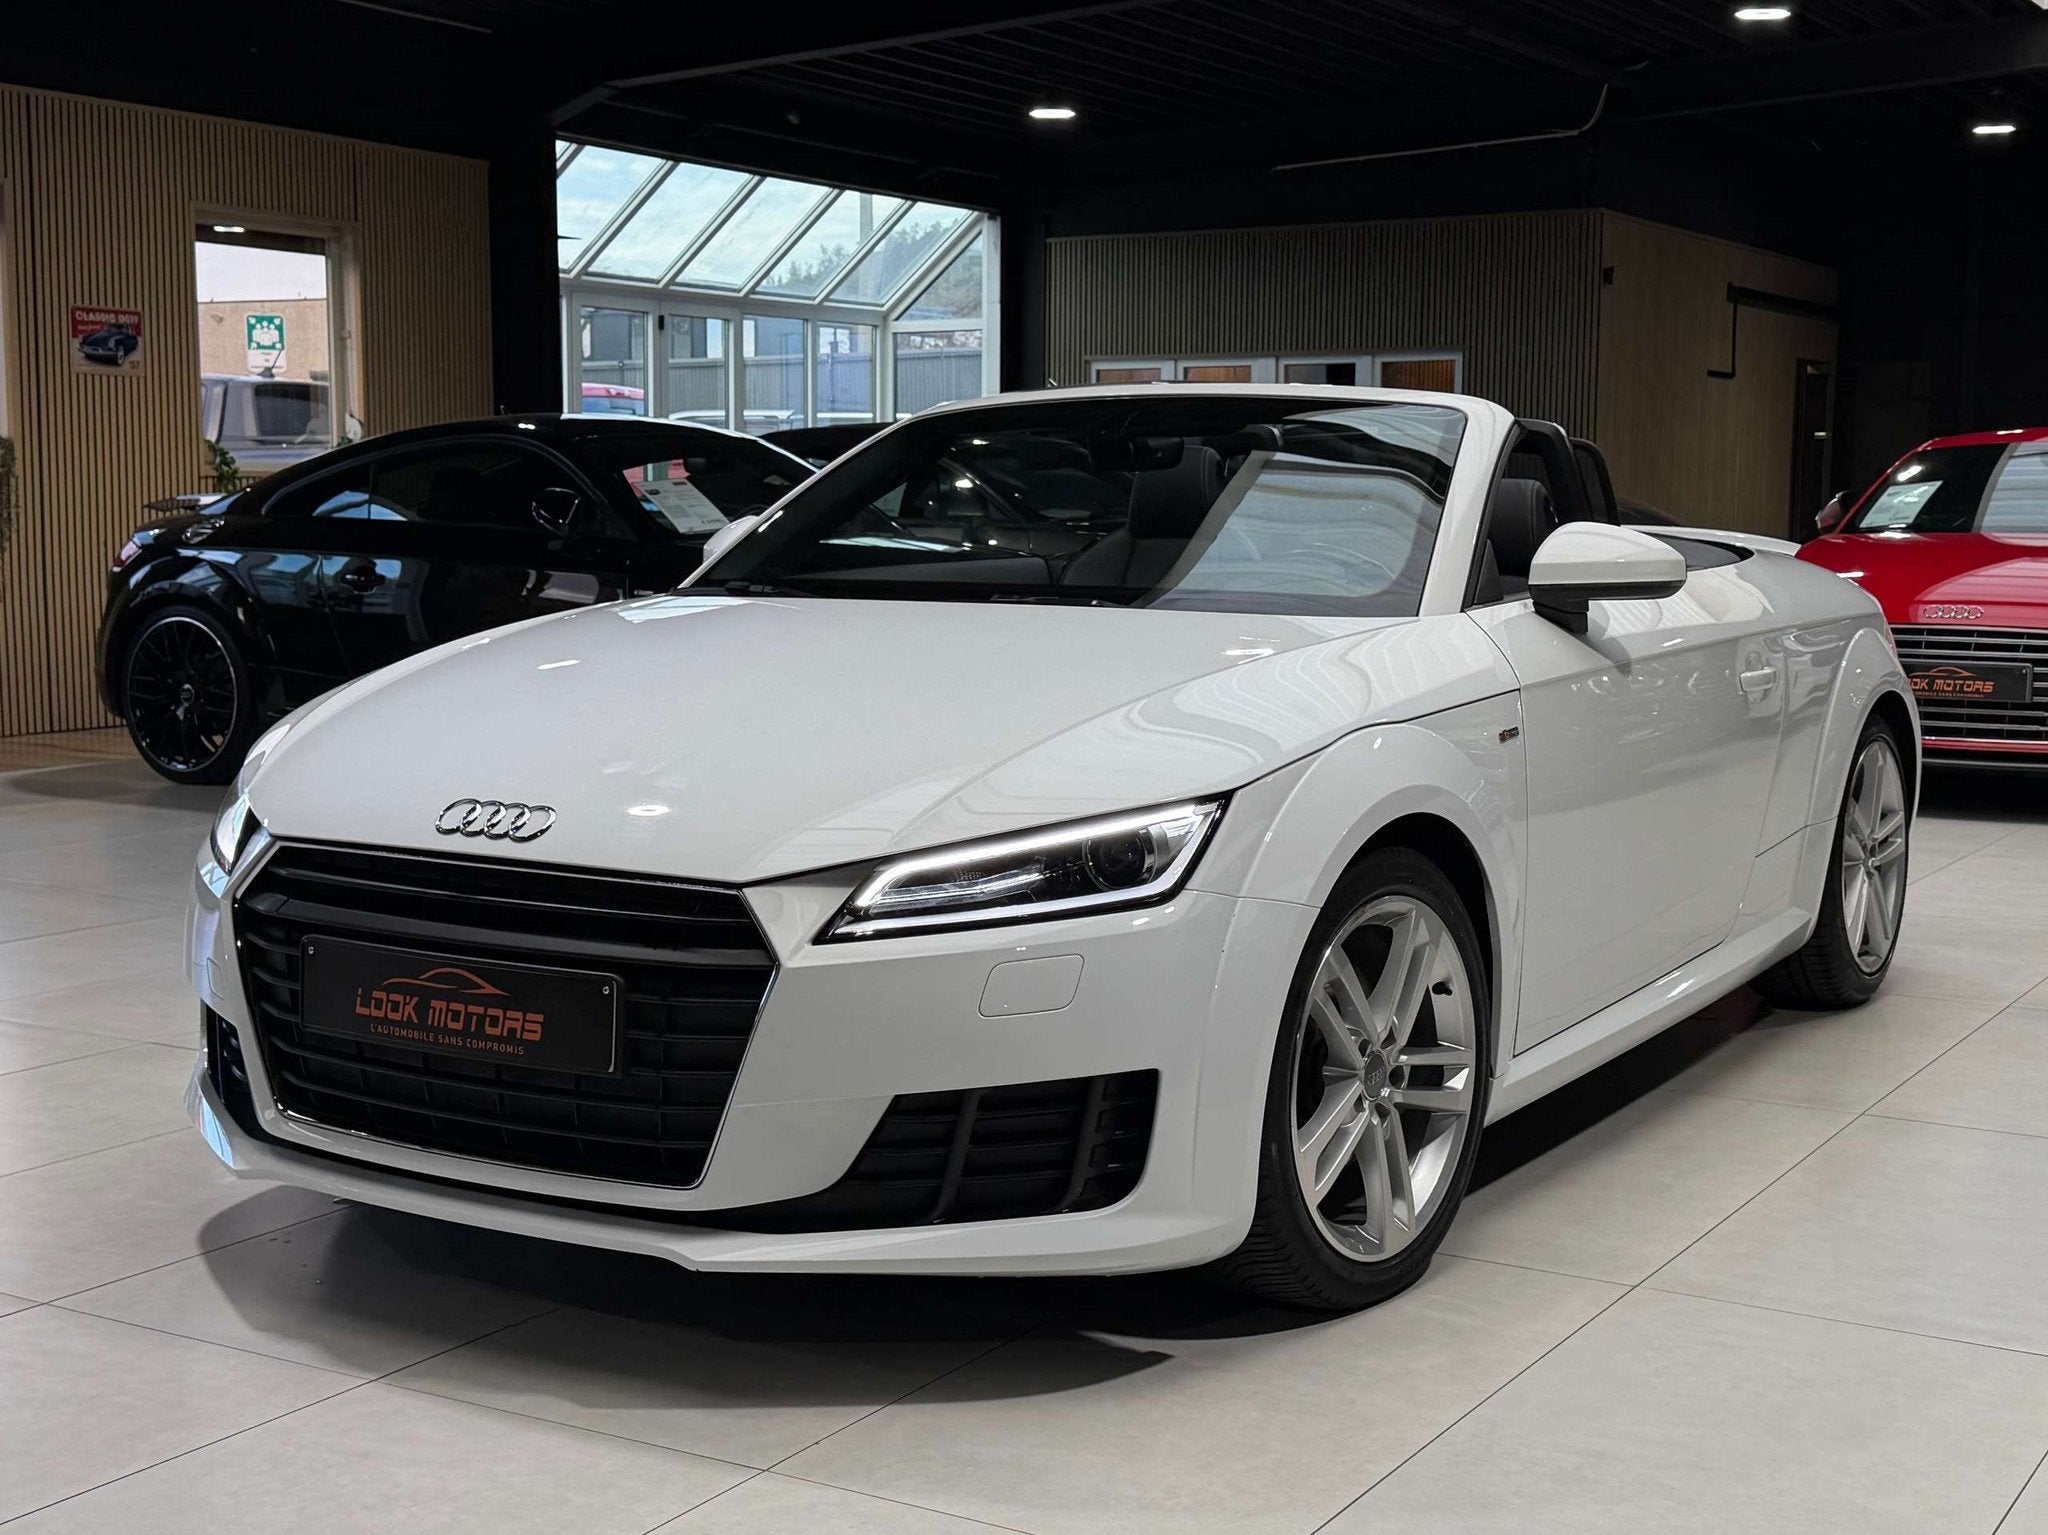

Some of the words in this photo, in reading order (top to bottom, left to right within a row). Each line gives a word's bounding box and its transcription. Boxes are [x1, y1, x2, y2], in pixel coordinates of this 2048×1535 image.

[75, 310, 117, 324] CLASSIC
[1907, 678, 1929, 691] OK
[1932, 679, 1995, 693] MOTORS
[355, 988, 420, 1024] LOOK
[427, 999, 545, 1041] MOTORS
[370, 1023, 434, 1042] L'AUTOMOBILE
[438, 1035, 463, 1047] SANS
[466, 1039, 526, 1056] COMPROMIS
